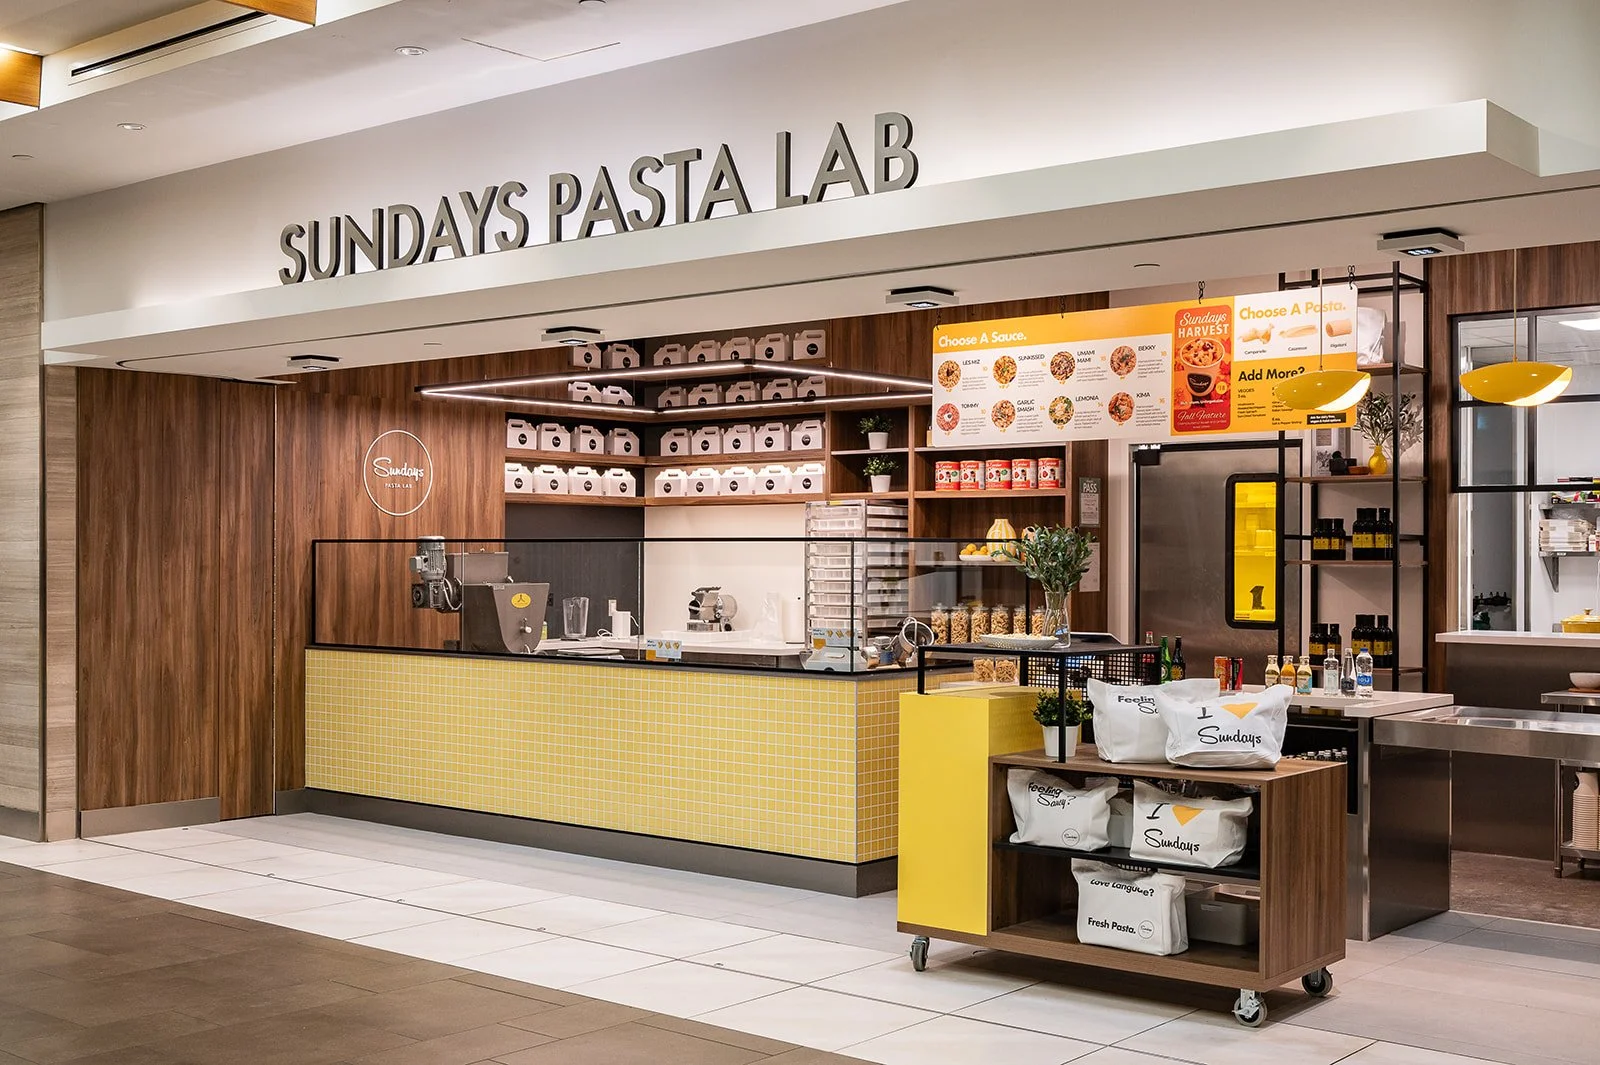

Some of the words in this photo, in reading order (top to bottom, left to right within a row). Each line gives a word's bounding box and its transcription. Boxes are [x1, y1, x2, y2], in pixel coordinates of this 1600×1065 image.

[278, 181, 528, 285] SUNDAYS
[549, 143, 753, 242] PASTA
[776, 111, 920, 205] LAB
[1180, 311, 1227, 327] Sundays
[1239, 306, 1287, 320] Choose
[1290, 303, 1301, 316] A
[1305, 301, 1346, 314] Pasta.
[938, 334, 978, 348] Choose
[980, 332, 989, 344] A
[991, 331, 1027, 343] Sauce.
[1178, 324, 1229, 338] HARVEST
[1238, 369, 1263, 381] Add
[1266, 366, 1305, 380] More?
[373, 457, 424, 482] Sundays
[1083, 483, 1097, 493] PASS
[1118, 695, 1155, 703] Feelin
[1197, 725, 1262, 748] Sundays
[1146, 802, 1170, 820] I
[1144, 828, 1200, 855] Sundays
[1088, 917, 1109, 929] Fresh
[1112, 921, 1136, 934] Pasta.
